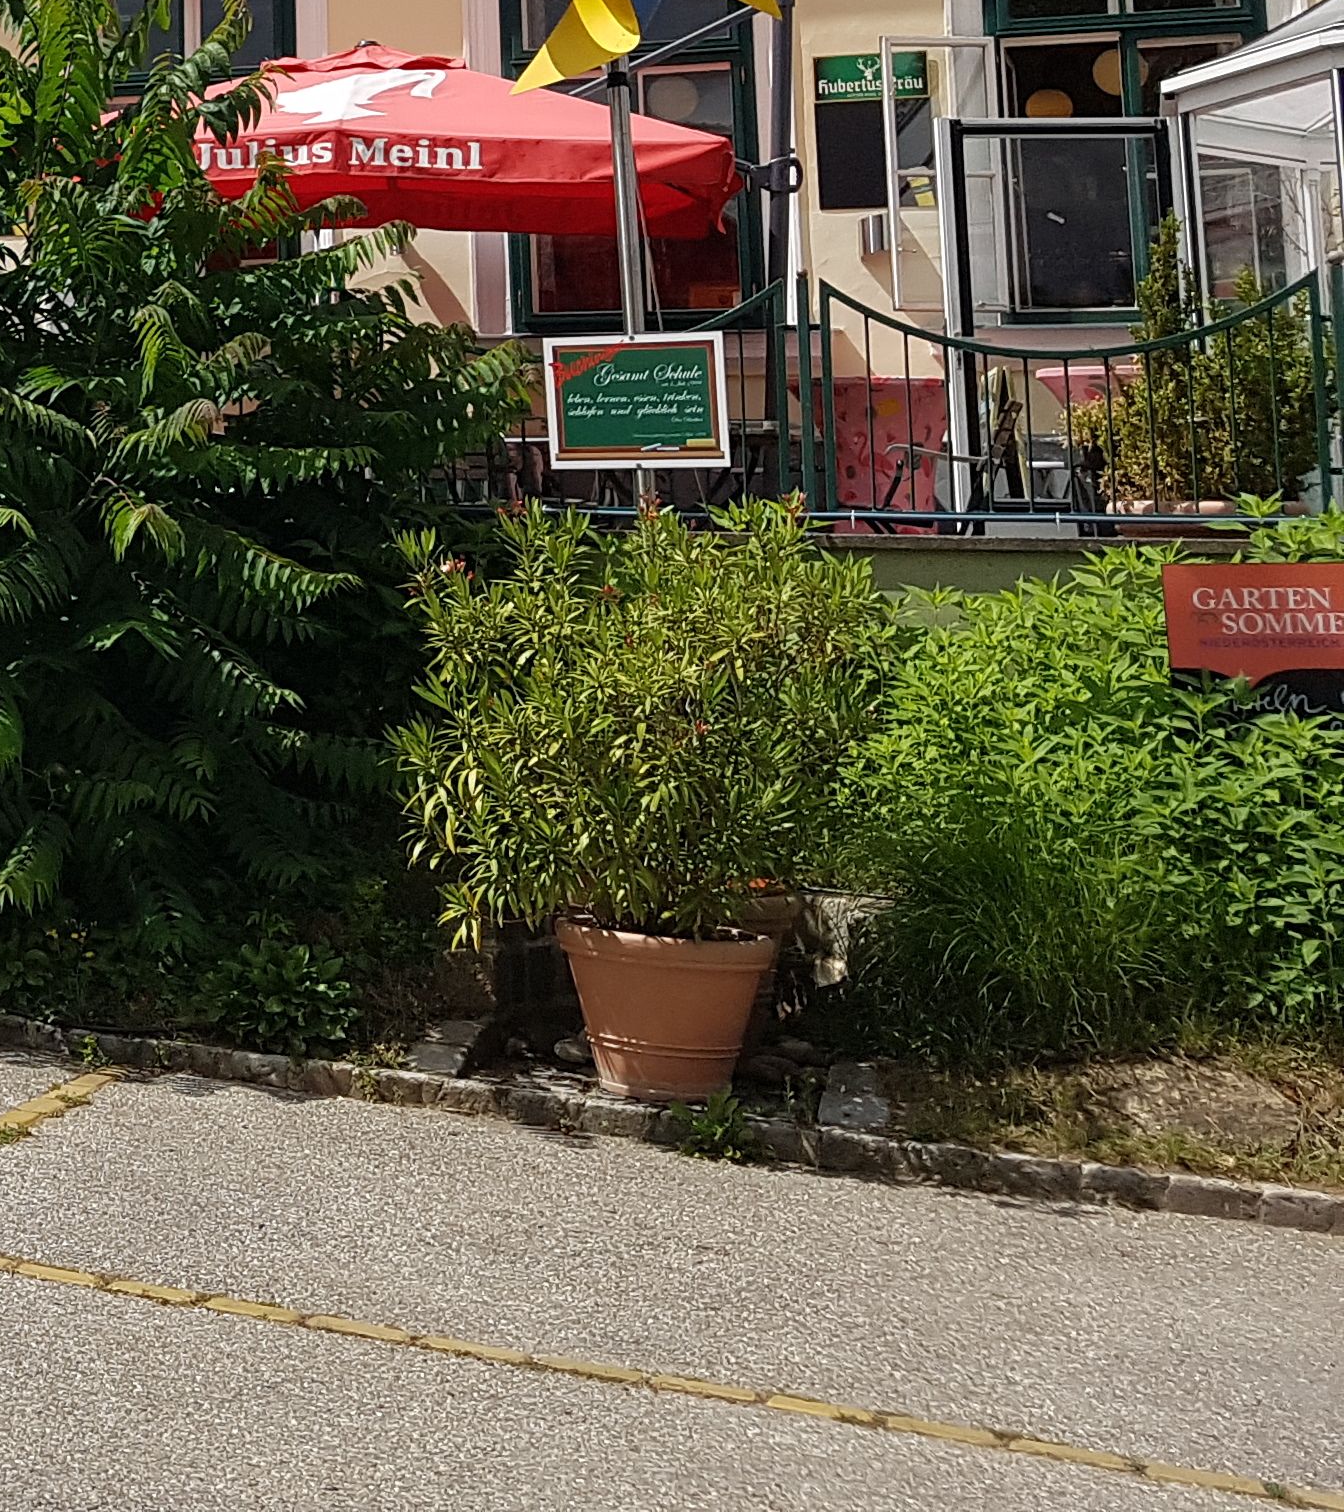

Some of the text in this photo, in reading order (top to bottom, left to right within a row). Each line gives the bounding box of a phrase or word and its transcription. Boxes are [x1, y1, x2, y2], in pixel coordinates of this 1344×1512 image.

[348, 137, 483, 170] Meinl
[653, 361, 703, 382] Schule
[1192, 587, 1332, 610] GARTEN
